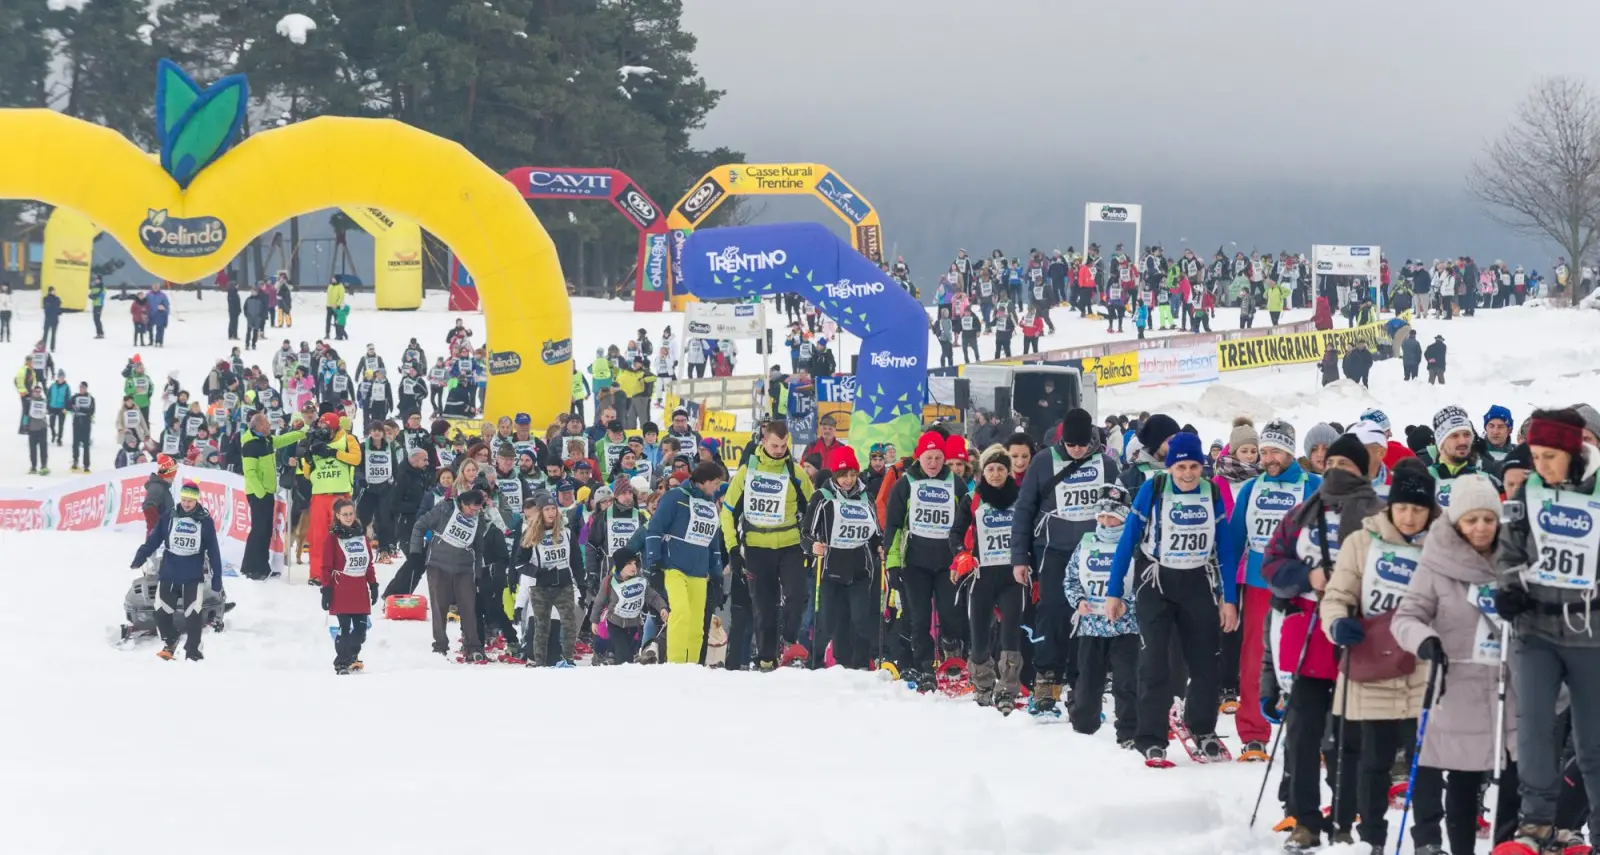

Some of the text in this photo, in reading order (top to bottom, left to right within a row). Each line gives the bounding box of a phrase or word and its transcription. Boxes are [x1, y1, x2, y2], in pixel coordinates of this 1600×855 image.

[529, 171, 612, 188] CAVIT
[746, 166, 813, 177] Casse Rurali
[756, 177, 804, 188] Trentine
[141, 222, 223, 245] Melinda
[651, 234, 667, 287] TRENTINO
[706, 246, 787, 273] TRENTINO
[825, 279, 884, 299] TRENTINO
[870, 351, 917, 368] TRENTINO
[1219, 335, 1321, 369] TRENTINGRANA
[317, 470, 342, 480] STAFF
[369, 467, 389, 476] 3551
[752, 481, 782, 490] Melinda
[919, 490, 949, 500] Melinda
[1063, 489, 1098, 507] 2799
[1256, 495, 1294, 506] Melinda
[750, 497, 780, 514] 3627
[841, 507, 867, 516] Melinda
[915, 508, 950, 525] 2505
[1171, 508, 1207, 520] Melinda
[1540, 510, 1590, 532] Melinda
[450, 525, 471, 541] 3567
[692, 520, 715, 536] 3603
[839, 525, 870, 539] 2518
[174, 536, 196, 548] 2579
[1170, 533, 1207, 551] 2730
[349, 557, 368, 567] 2580
[545, 548, 567, 561] 3518
